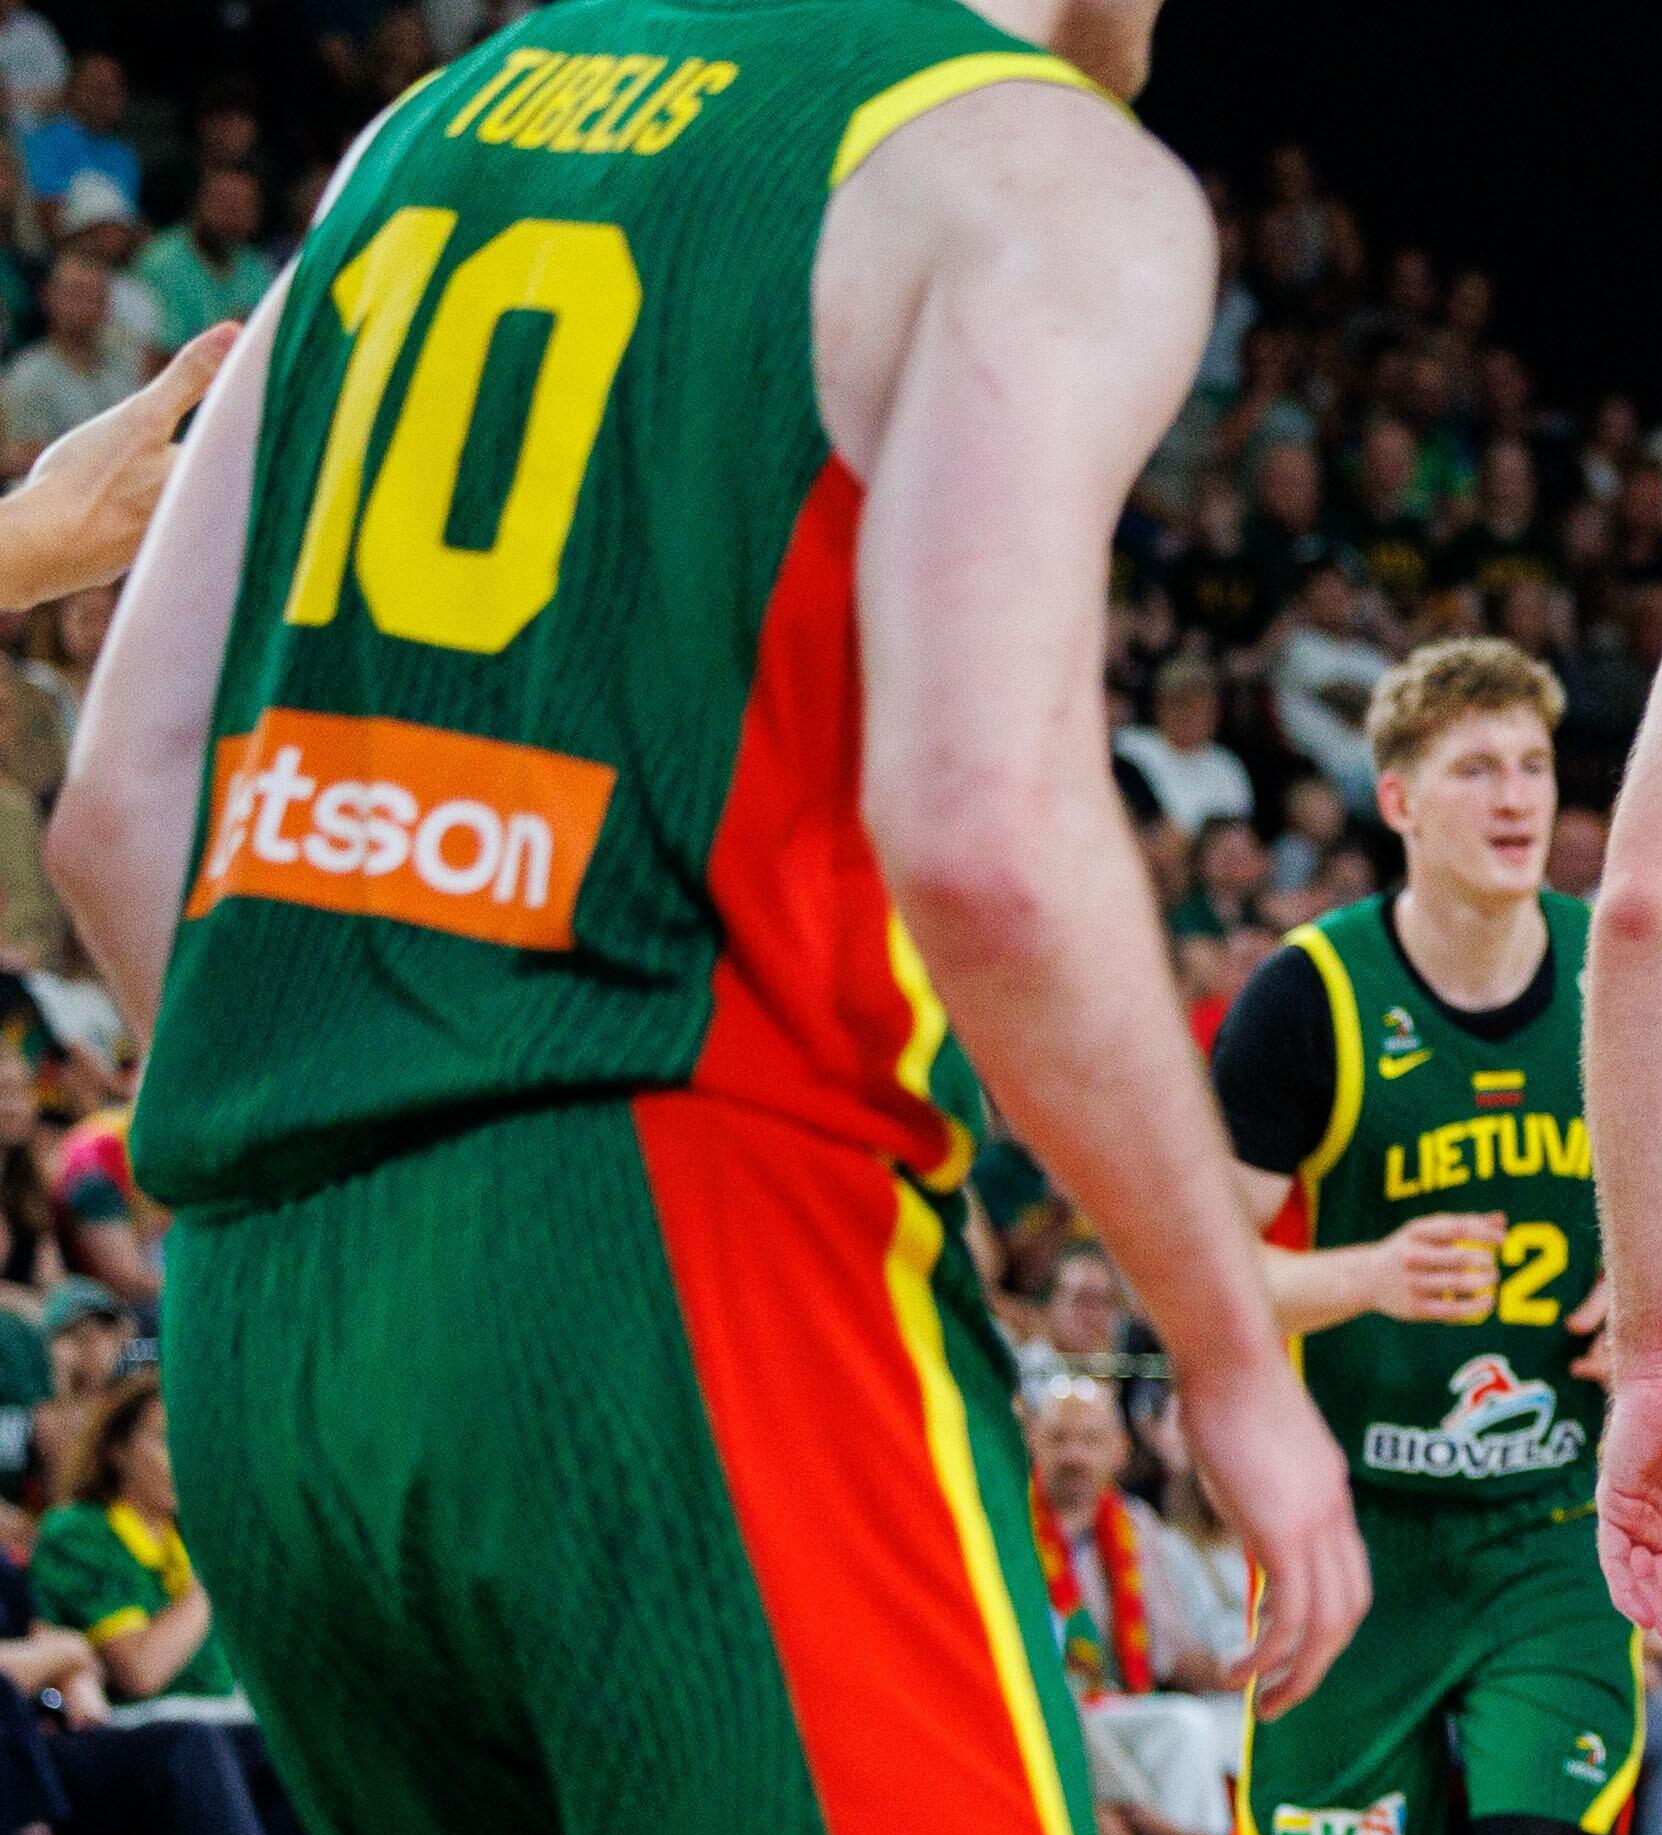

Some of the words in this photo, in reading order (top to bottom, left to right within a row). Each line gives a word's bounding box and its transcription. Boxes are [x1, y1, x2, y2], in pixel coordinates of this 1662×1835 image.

[445, 48, 740, 156] TUBELIS
[285, 205, 644, 656] 10
[1384, 1112, 1593, 1200] LIETUV
